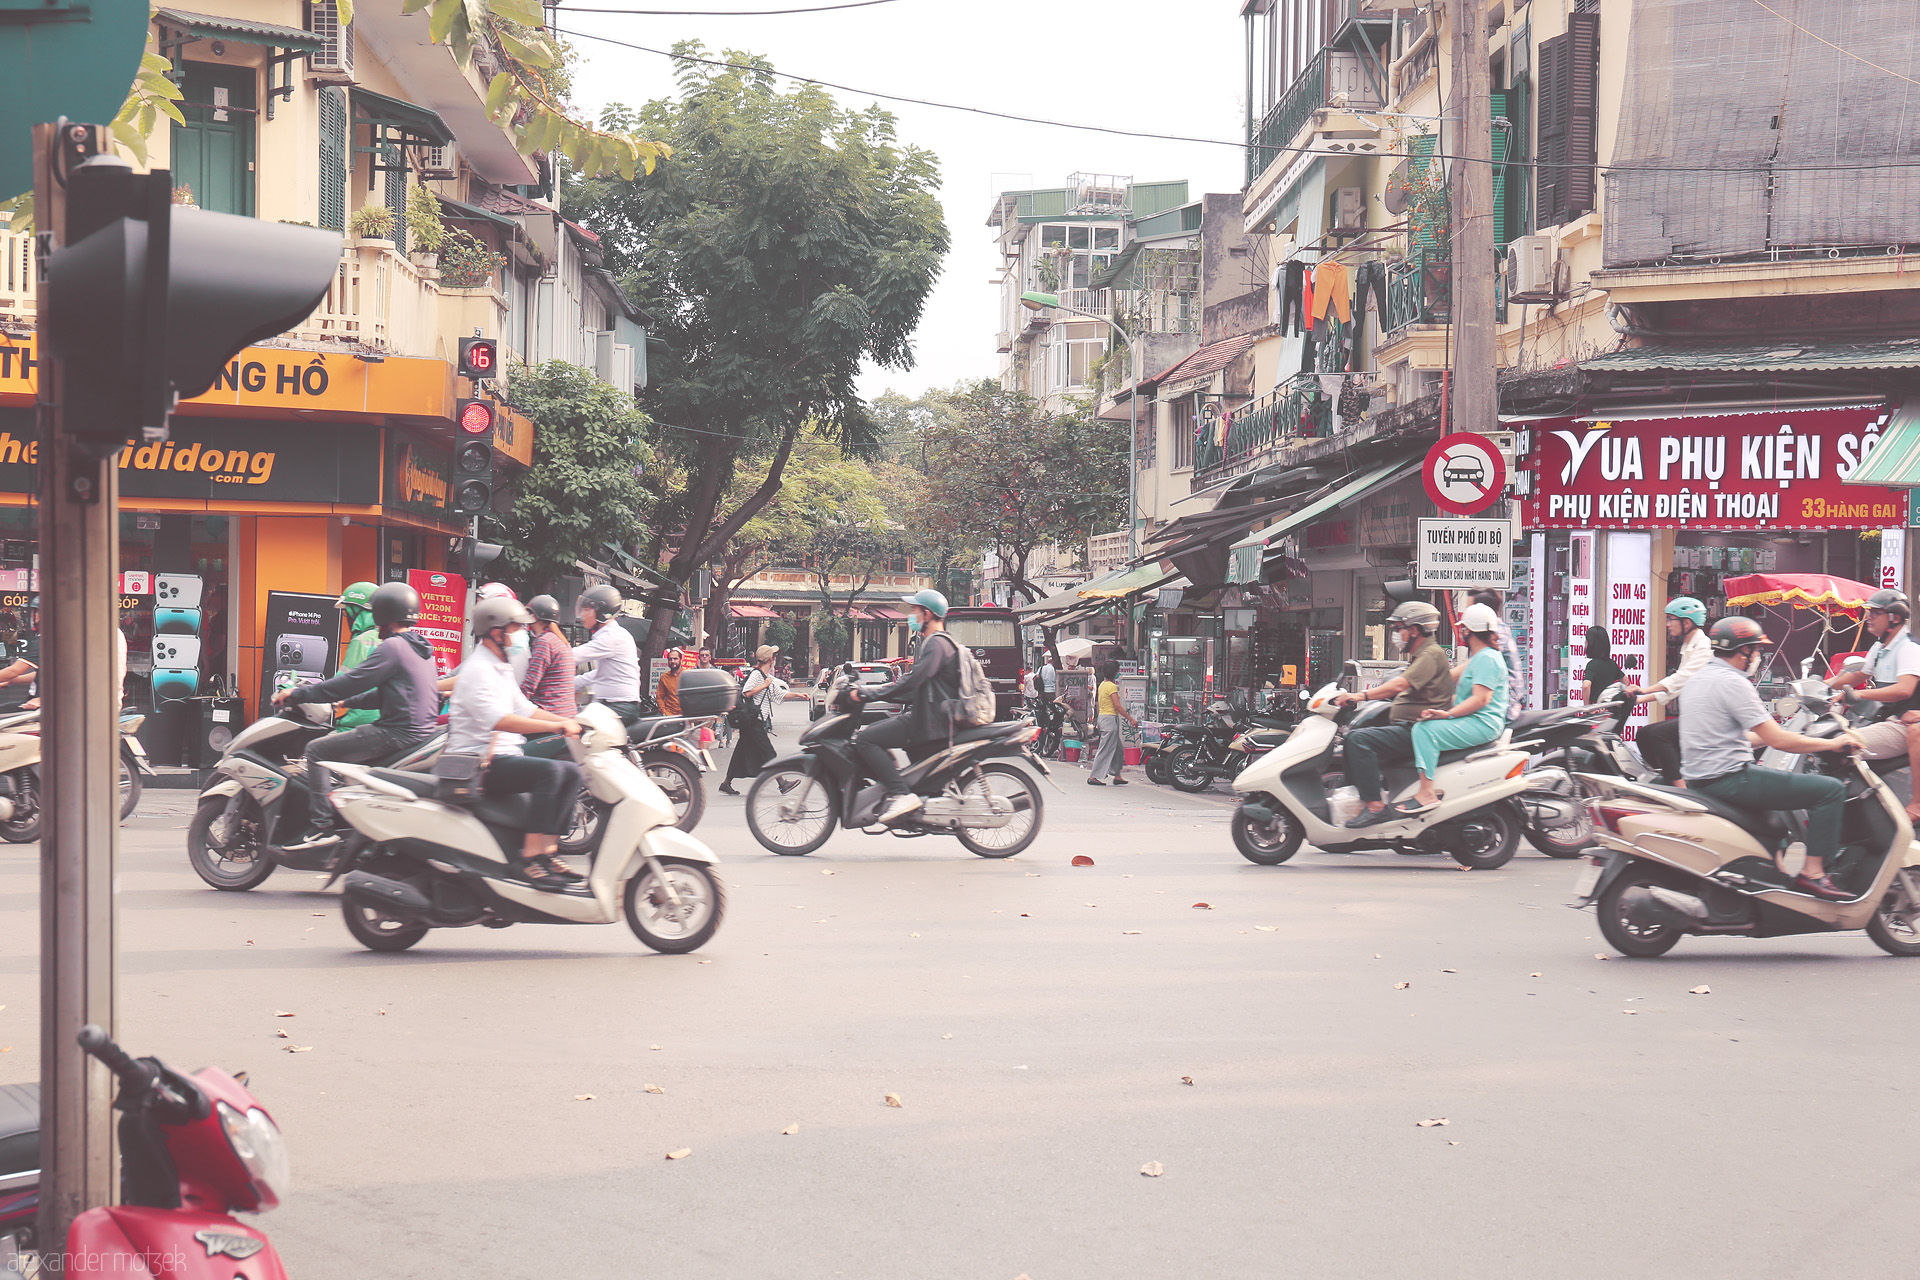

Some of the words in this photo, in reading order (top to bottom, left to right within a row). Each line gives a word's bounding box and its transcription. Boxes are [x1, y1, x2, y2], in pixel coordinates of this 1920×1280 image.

[471, 348, 490, 368] 16
[276, 353, 329, 396] HỒ
[1659, 435, 1726, 489] PHỤ
[1741, 424, 1821, 488] KIỆN
[1550, 494, 1592, 525] PHỤ
[1599, 487, 1650, 524] KIỆN
[1655, 487, 1707, 524] ĐIỆN
[1714, 493, 1779, 525] THOẠI
[1872, 504, 1897, 518] GAI
[1427, 526, 1454, 544] TUYẾN
[1458, 526, 1476, 544] PHỐ
[1478, 530, 1487, 544] ĐI
[1490, 527, 1502, 548] BỘ
[1439, 553, 1453, 563] 19H00
[1489, 550, 1499, 563] ĐẾN
[1424, 569, 1439, 580] 24H00
[1454, 566, 1463, 580] CHỦ
[1464, 568, 1477, 582] NHẬT
[348, 591, 366, 600] Grab
[421, 593, 456, 603] VIETTEL
[1573, 585, 1588, 599] PHỤ
[1613, 583, 1631, 600] SIM
[1634, 583, 1646, 600] 4G
[424, 603, 451, 612] V120N
[1572, 602, 1589, 619] KIỆN
[1612, 608, 1645, 625] PHONE
[430, 630, 445, 638] 4GB
[1572, 622, 1589, 639] ĐIỆN
[1612, 629, 1645, 646] REPAIR
[1570, 644, 1587, 659] THOẠ
[1572, 664, 1586, 680] SỬ
